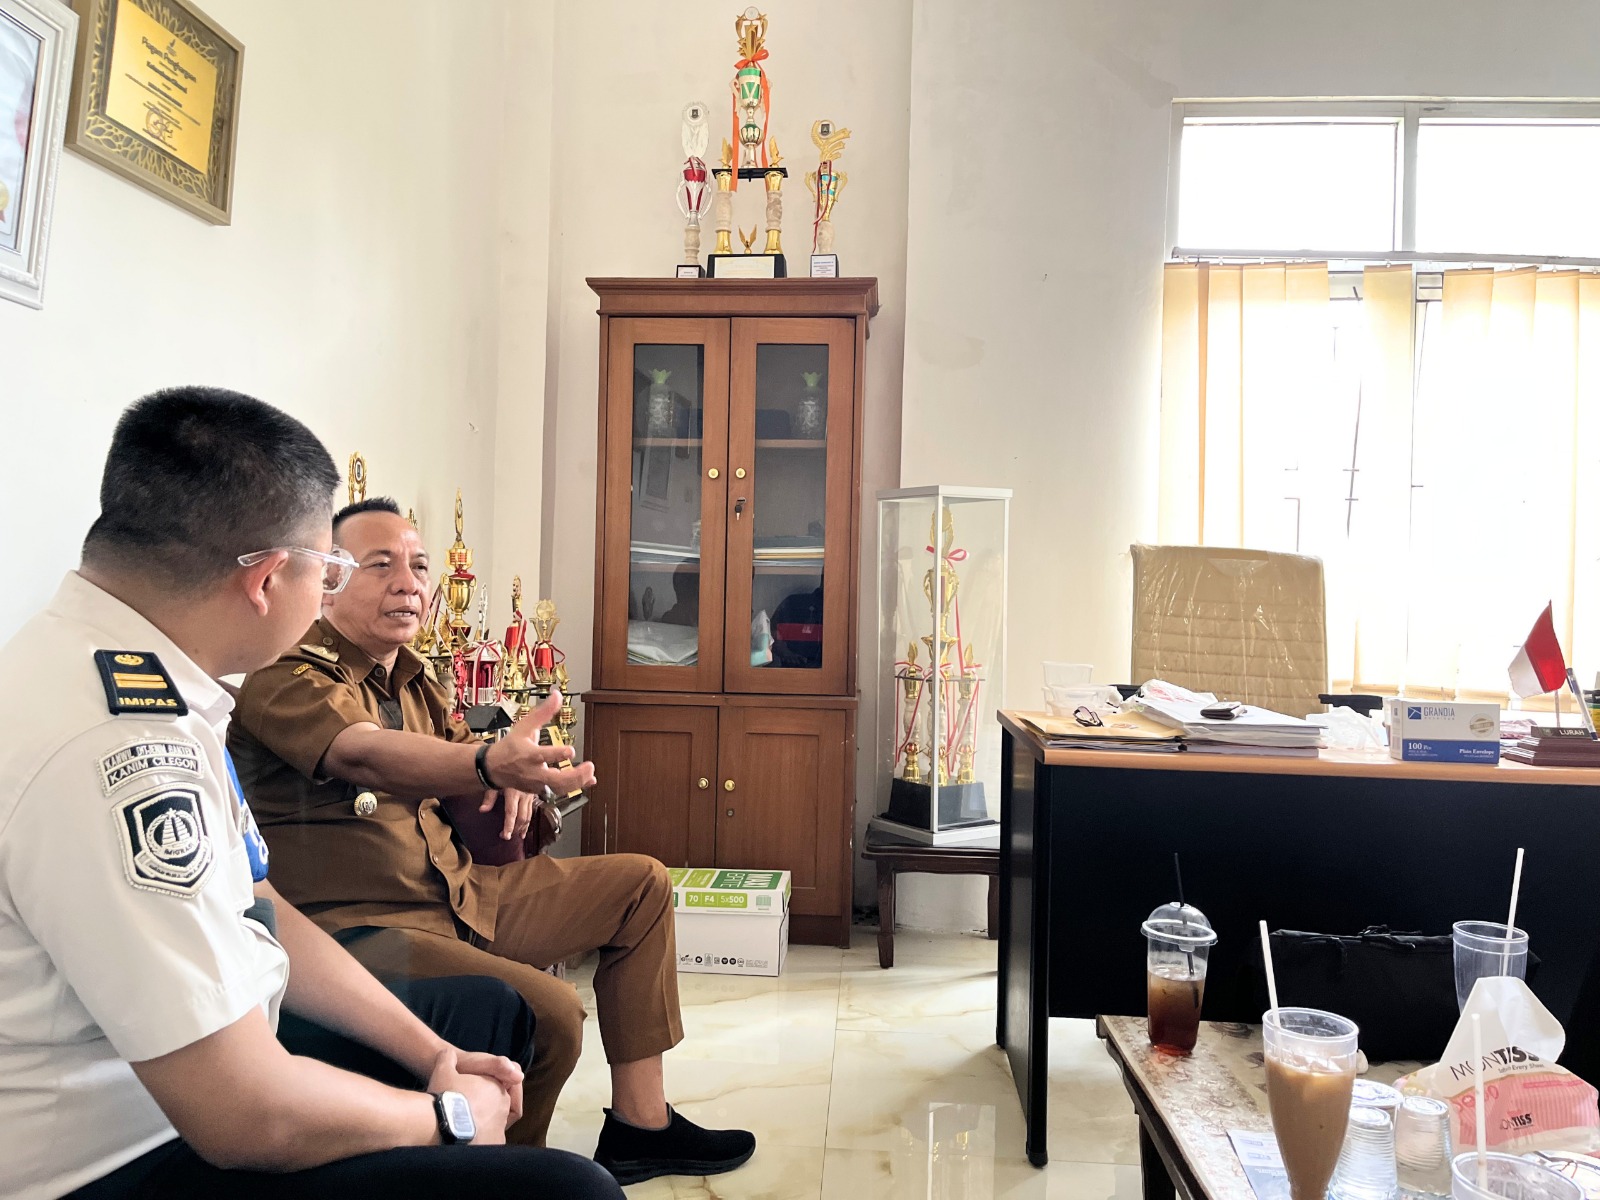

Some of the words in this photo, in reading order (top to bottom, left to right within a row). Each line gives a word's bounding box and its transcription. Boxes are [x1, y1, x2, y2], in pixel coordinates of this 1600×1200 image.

[118, 697, 178, 707] IMIPAS
[1423, 706, 1455, 717] GRANDIA
[1408, 742, 1423, 750] 100
[109, 759, 149, 785] KANIM
[152, 756, 197, 771] CILEGON
[164, 843, 194, 856] IMIGRAS
[689, 895, 699, 903] 70
[720, 896, 745, 904] 5x500
[1500, 1113, 1533, 1131] ONTISS
